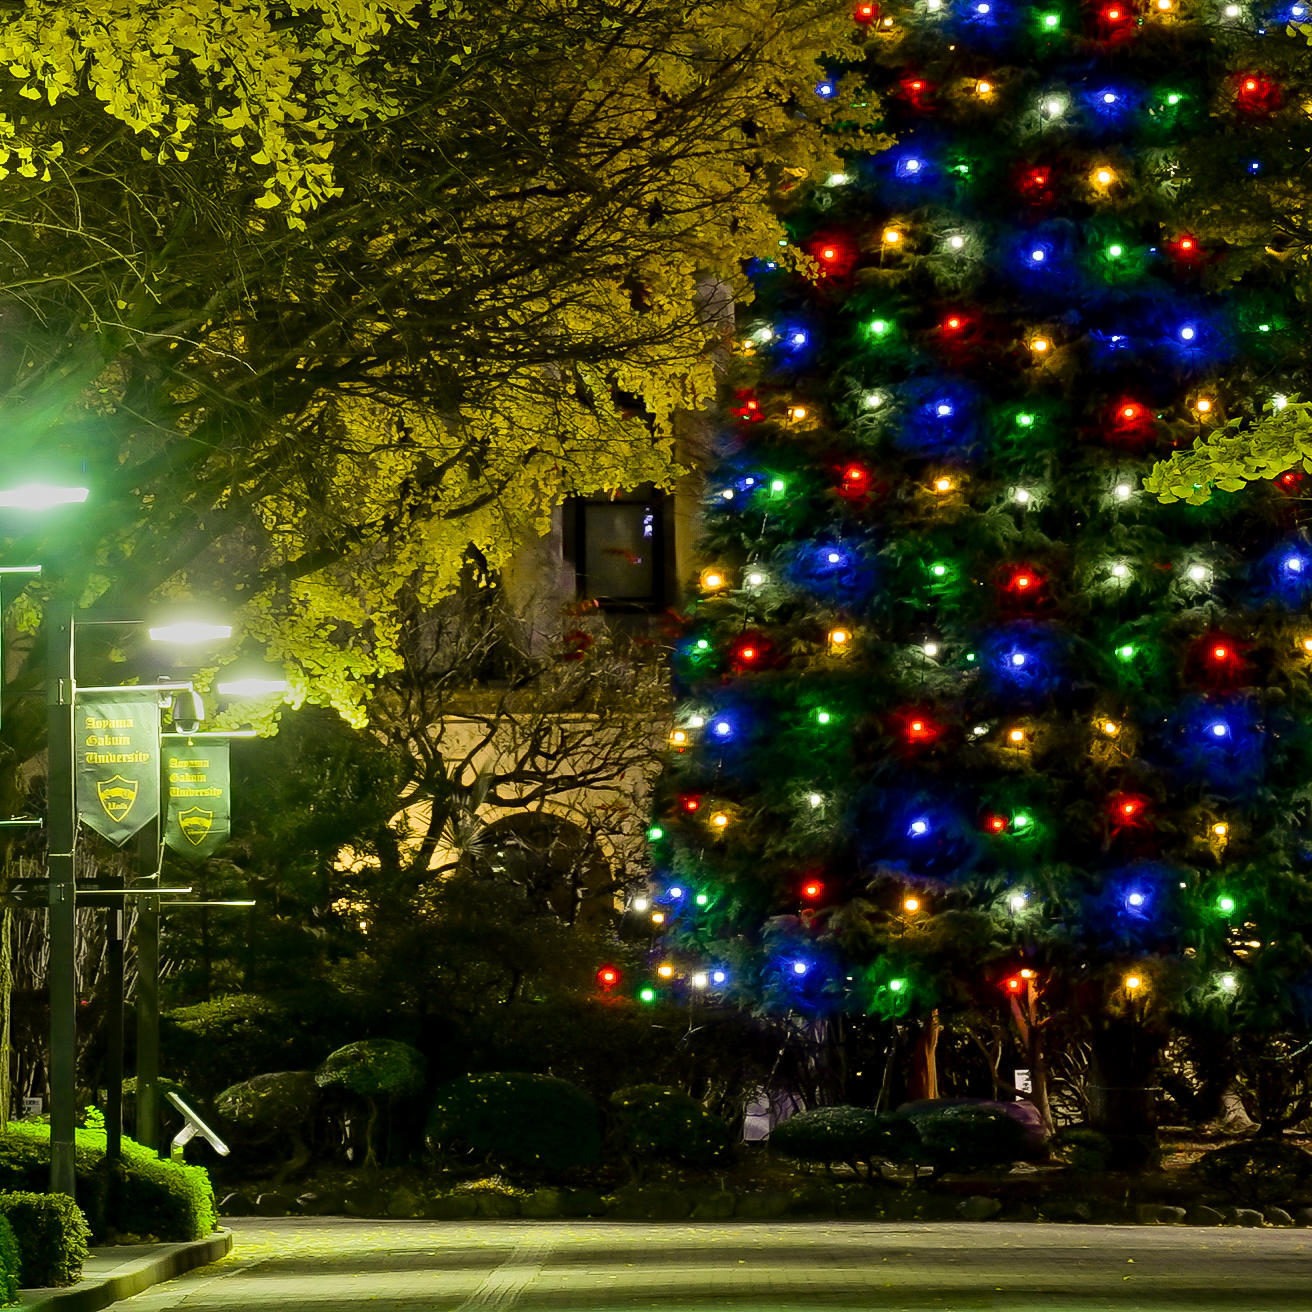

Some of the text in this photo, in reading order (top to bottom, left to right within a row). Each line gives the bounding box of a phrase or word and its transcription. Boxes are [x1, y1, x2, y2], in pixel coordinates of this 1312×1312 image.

[85, 717, 135, 730] Aoyama
[85, 734, 131, 747] Gakuin
[84, 751, 150, 765] University
[169, 786, 223, 798] University
